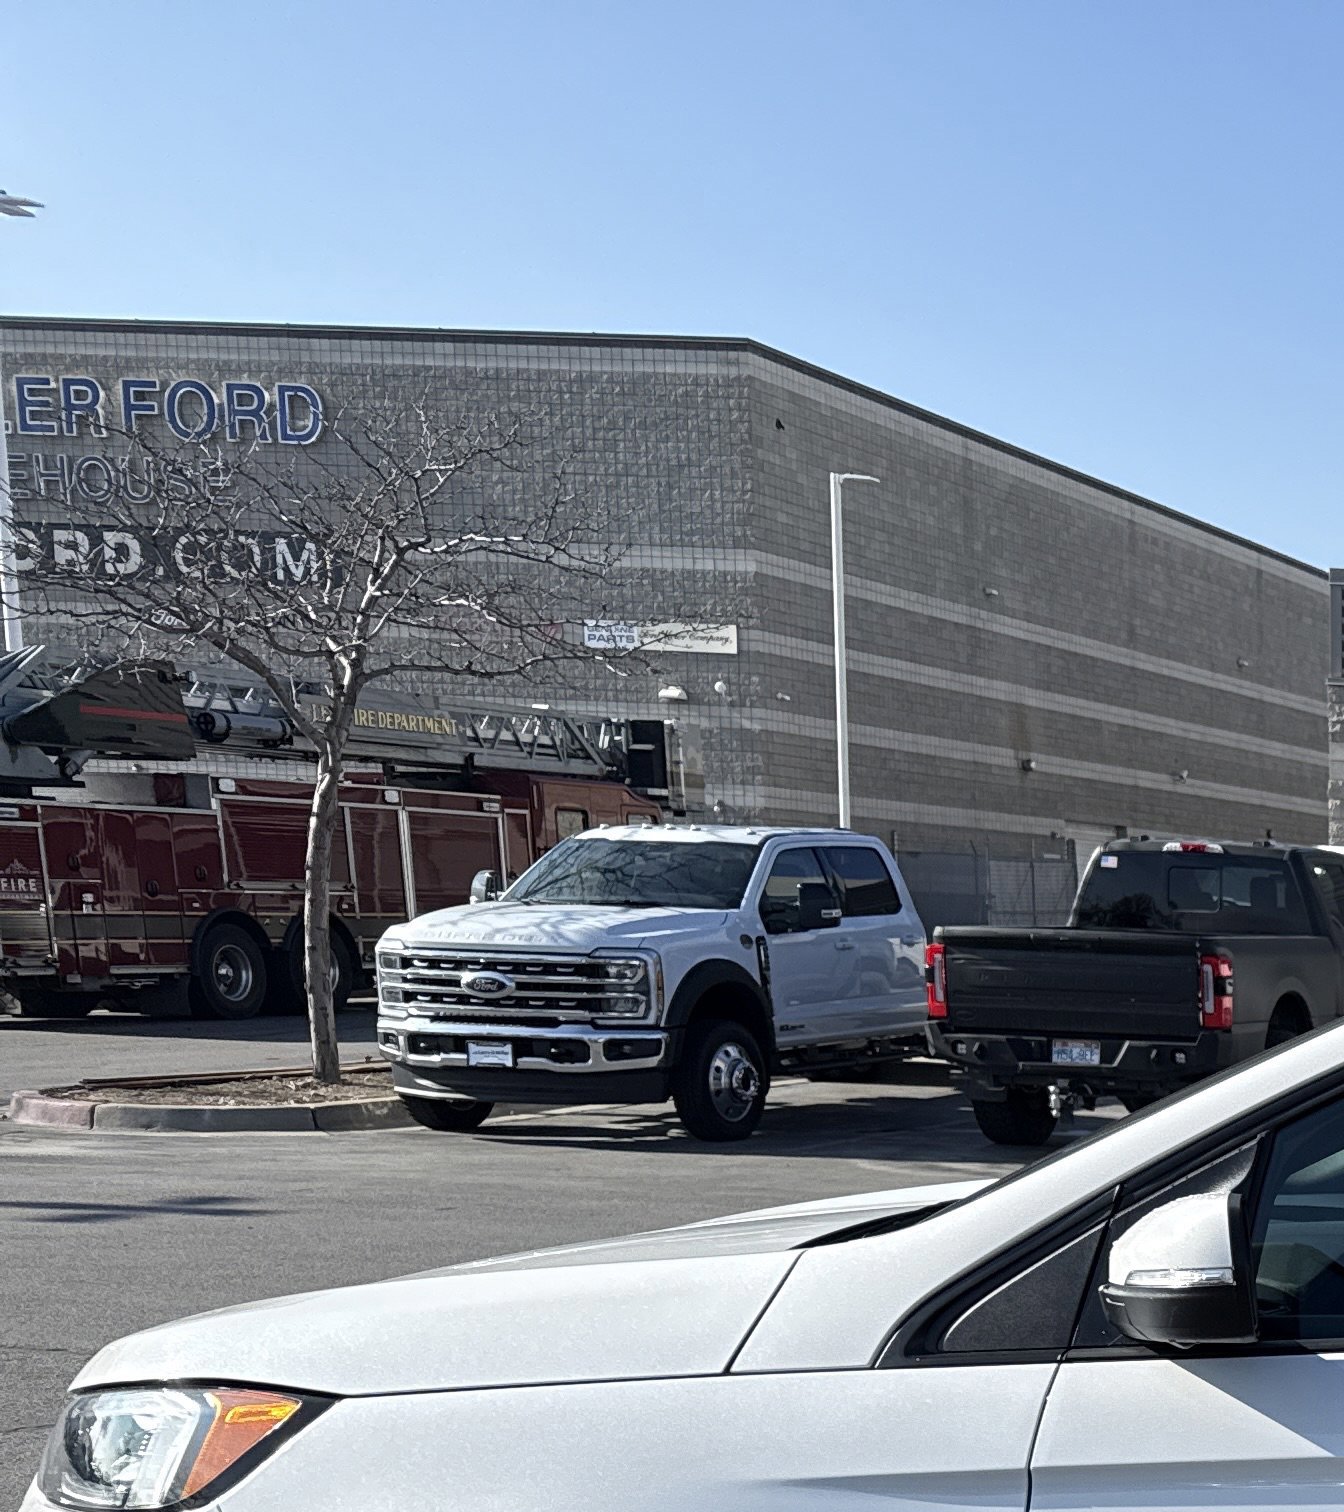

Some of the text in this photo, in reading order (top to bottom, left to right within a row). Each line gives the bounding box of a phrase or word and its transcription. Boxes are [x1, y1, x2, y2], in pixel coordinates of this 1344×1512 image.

[0, 374, 324, 446] ER FORD
[587, 633, 636, 645] PARTS
[353, 708, 376, 727] IRE
[378, 711, 457, 735] DEPARTMENT
[0, 877, 37, 892] FIRE
[473, 978, 499, 991] Ford
